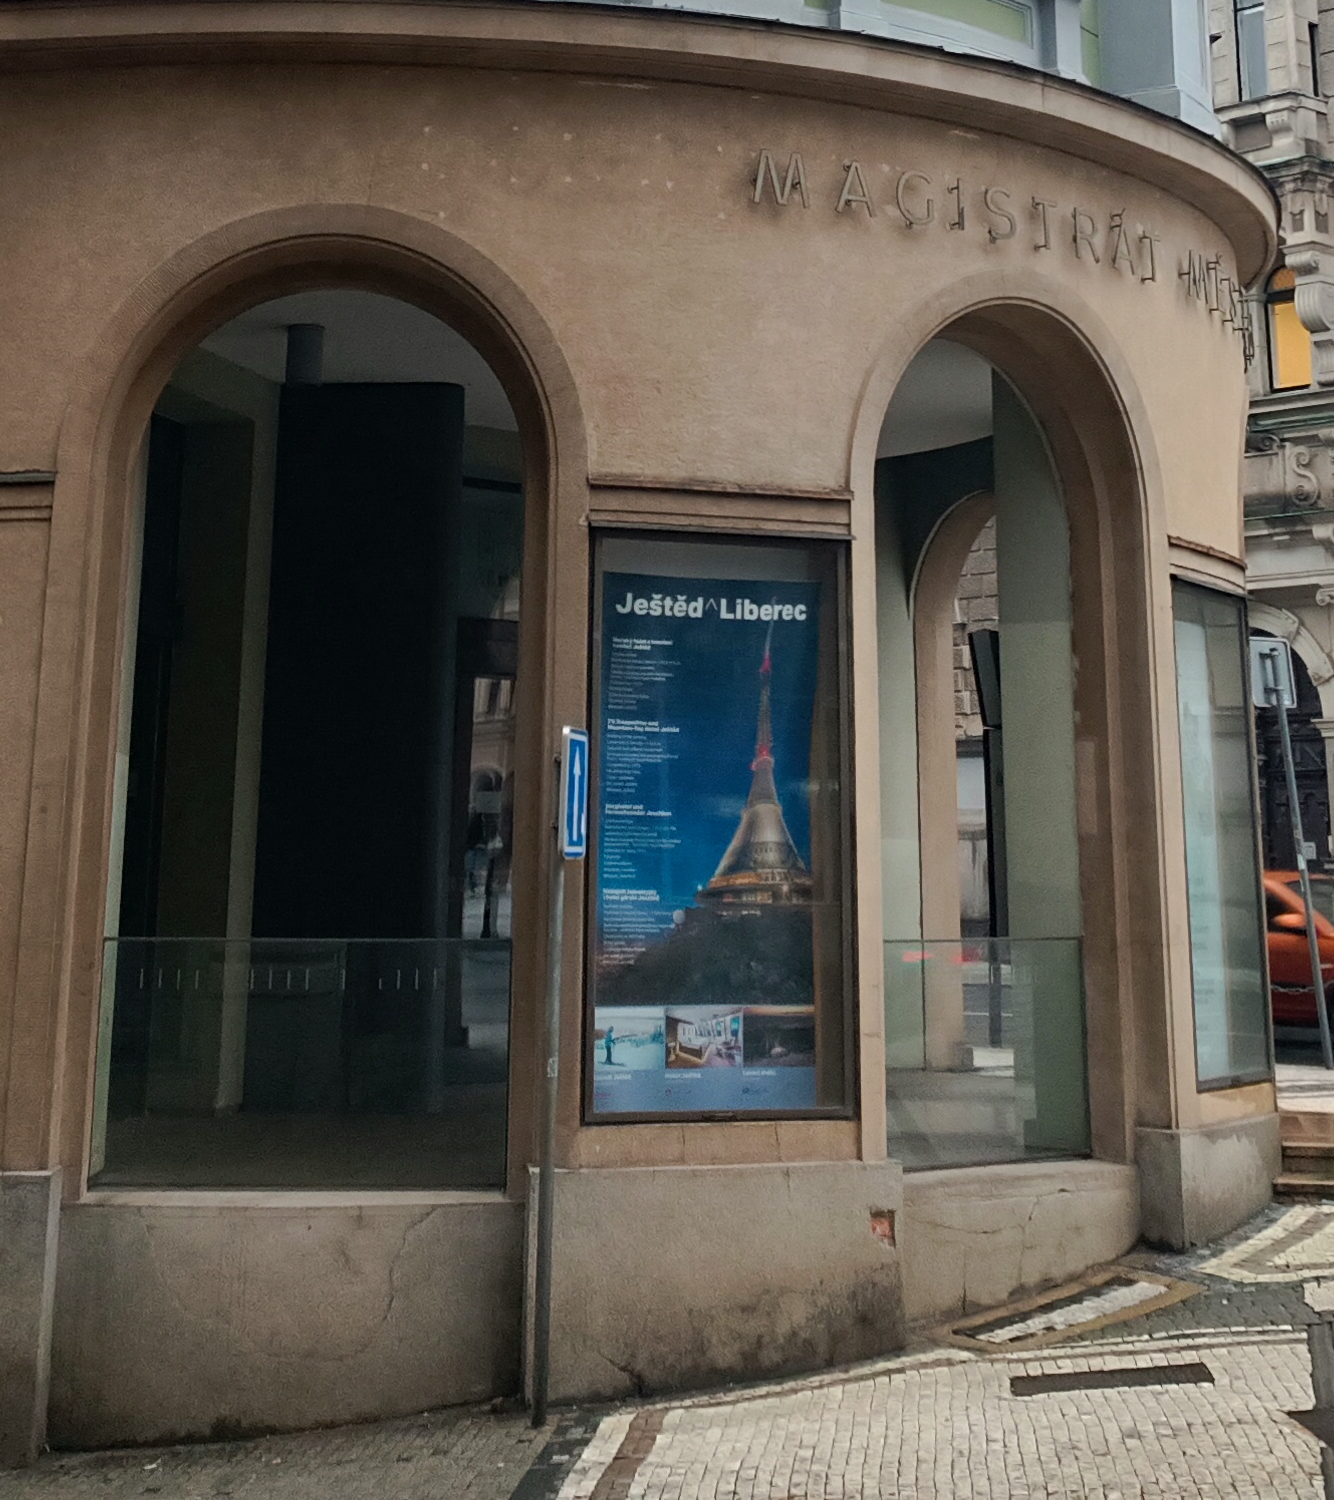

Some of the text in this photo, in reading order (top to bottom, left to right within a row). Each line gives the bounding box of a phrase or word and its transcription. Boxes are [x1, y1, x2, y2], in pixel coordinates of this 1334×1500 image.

[751, 148, 1161, 284] MAGISTRÁT
[615, 592, 808, 621] Ještěd Liberec
